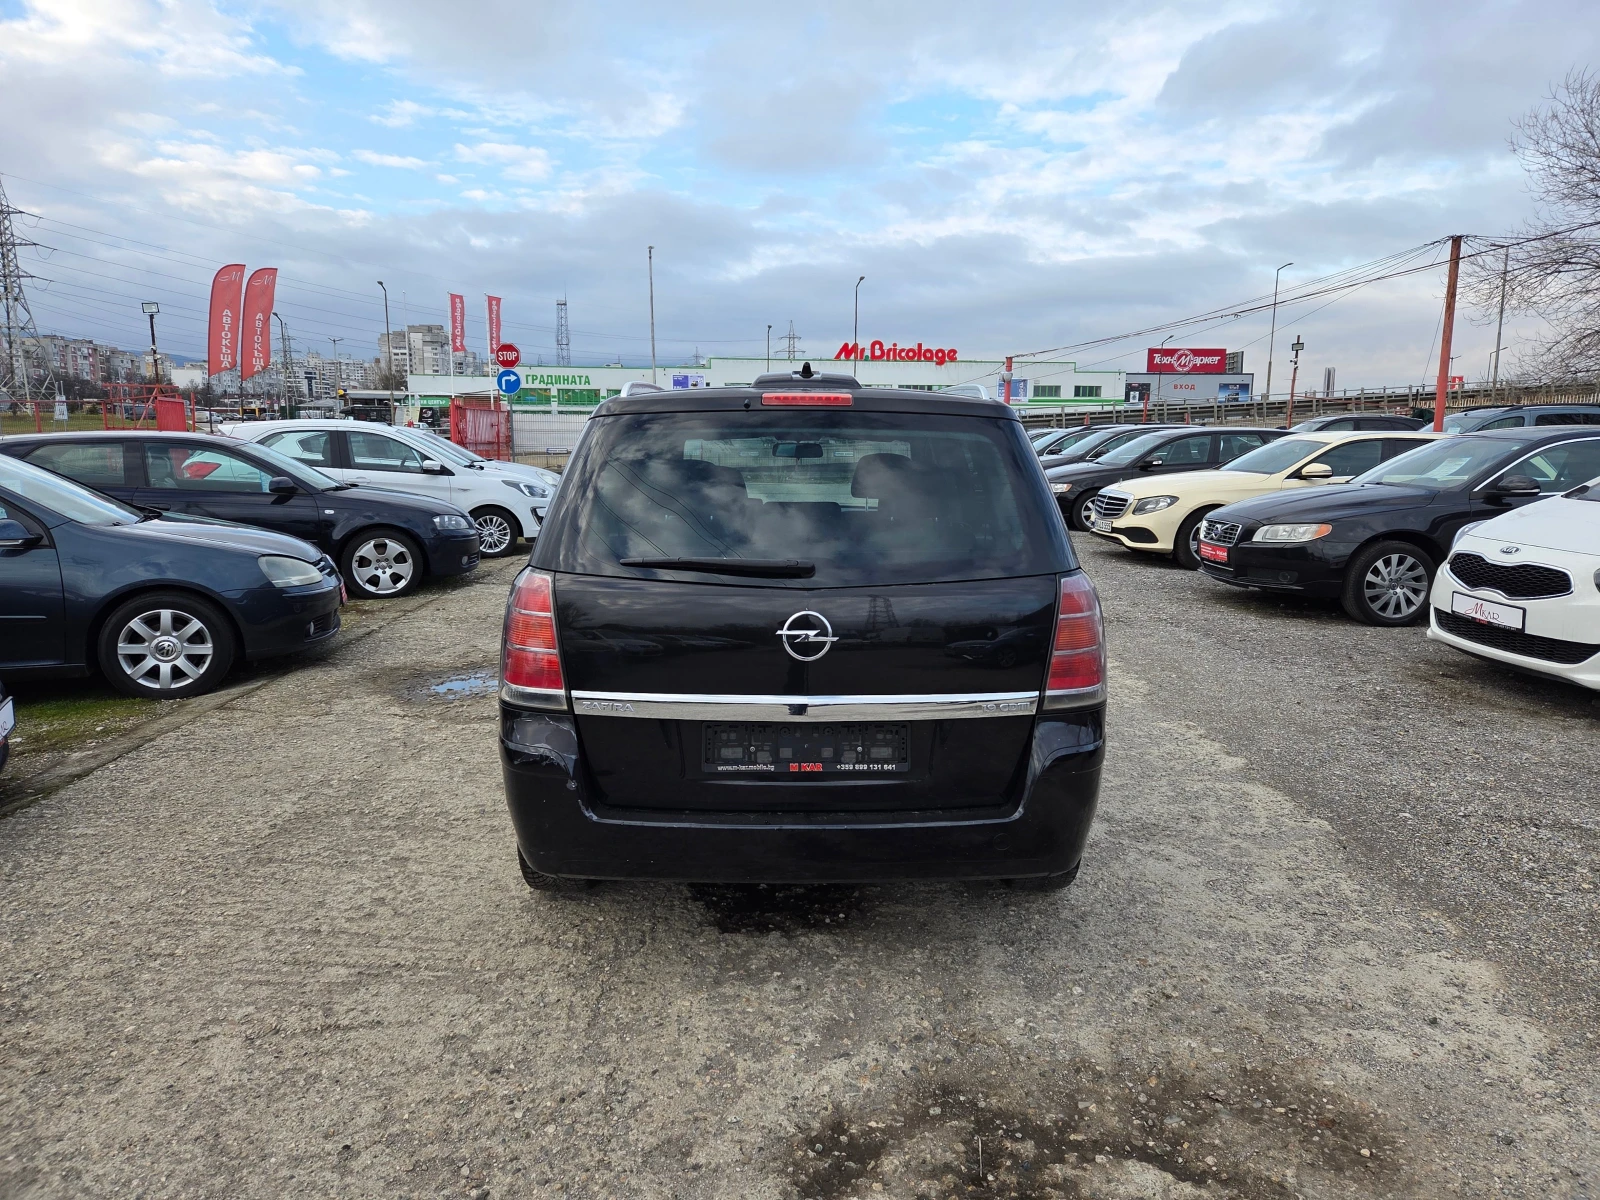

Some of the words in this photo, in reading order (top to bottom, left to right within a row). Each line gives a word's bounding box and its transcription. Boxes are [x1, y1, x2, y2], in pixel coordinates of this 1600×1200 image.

[220, 309, 232, 369] АВТОКЪЩА
[252, 312, 265, 372] АВТОКЪЩА
[498, 351, 518, 361] STOP
[525, 374, 591, 387] ГРАДИНАТА
[1173, 383, 1196, 391] ВХОД
[582, 701, 635, 712] ZAFIRA
[999, 702, 1030, 712] CDTI
[789, 763, 799, 772] M
[801, 763, 823, 772] KAR
